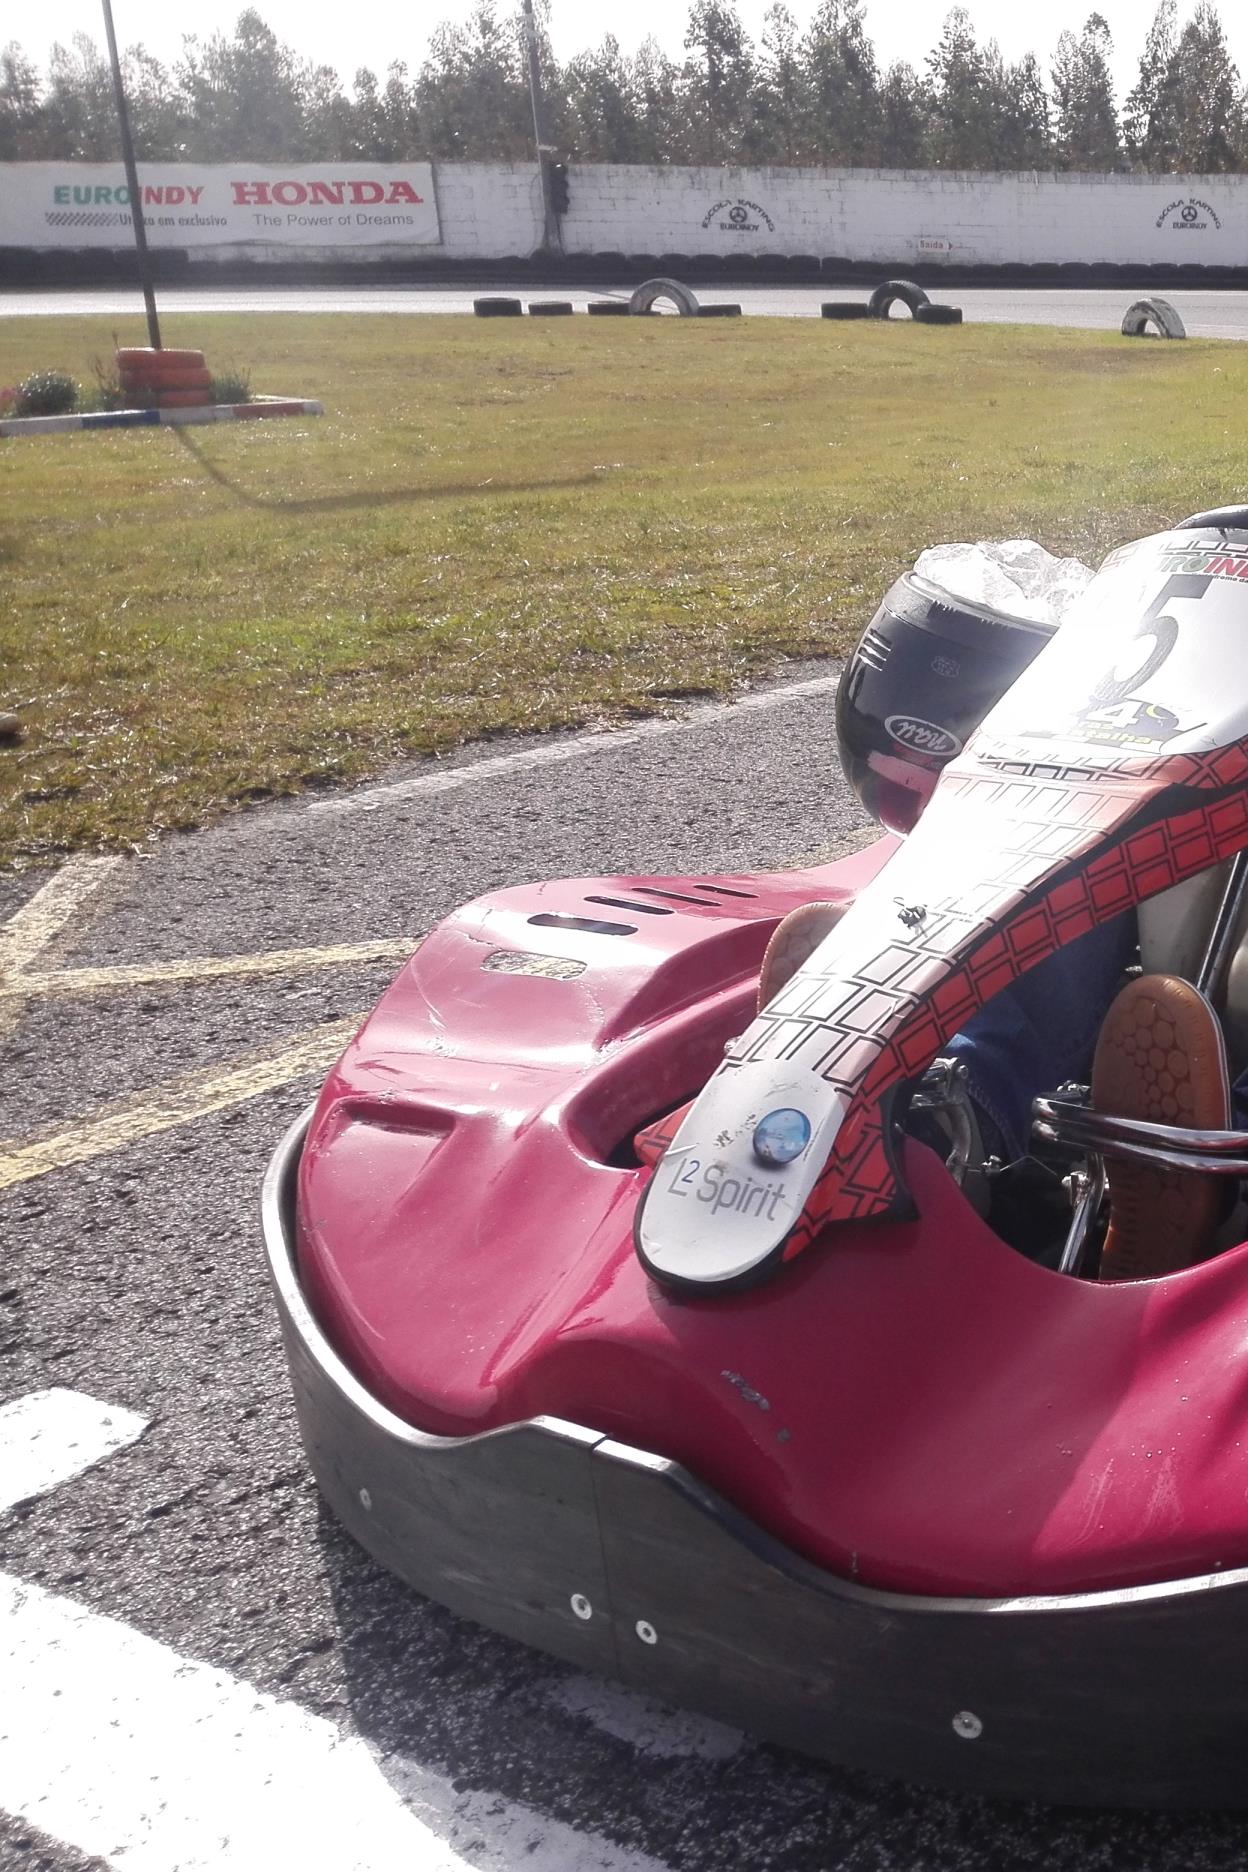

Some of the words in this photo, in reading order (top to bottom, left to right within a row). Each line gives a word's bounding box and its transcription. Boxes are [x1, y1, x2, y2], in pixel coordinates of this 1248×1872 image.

[230, 181, 424, 205] HONDA
[119, 214, 157, 226] Utza
[178, 213, 227, 226] exclusivo
[253, 214, 282, 226] The
[287, 214, 333, 226] Power
[337, 213, 351, 225] of
[356, 213, 414, 225] Dreams
[1090, 574, 1214, 700] 5
